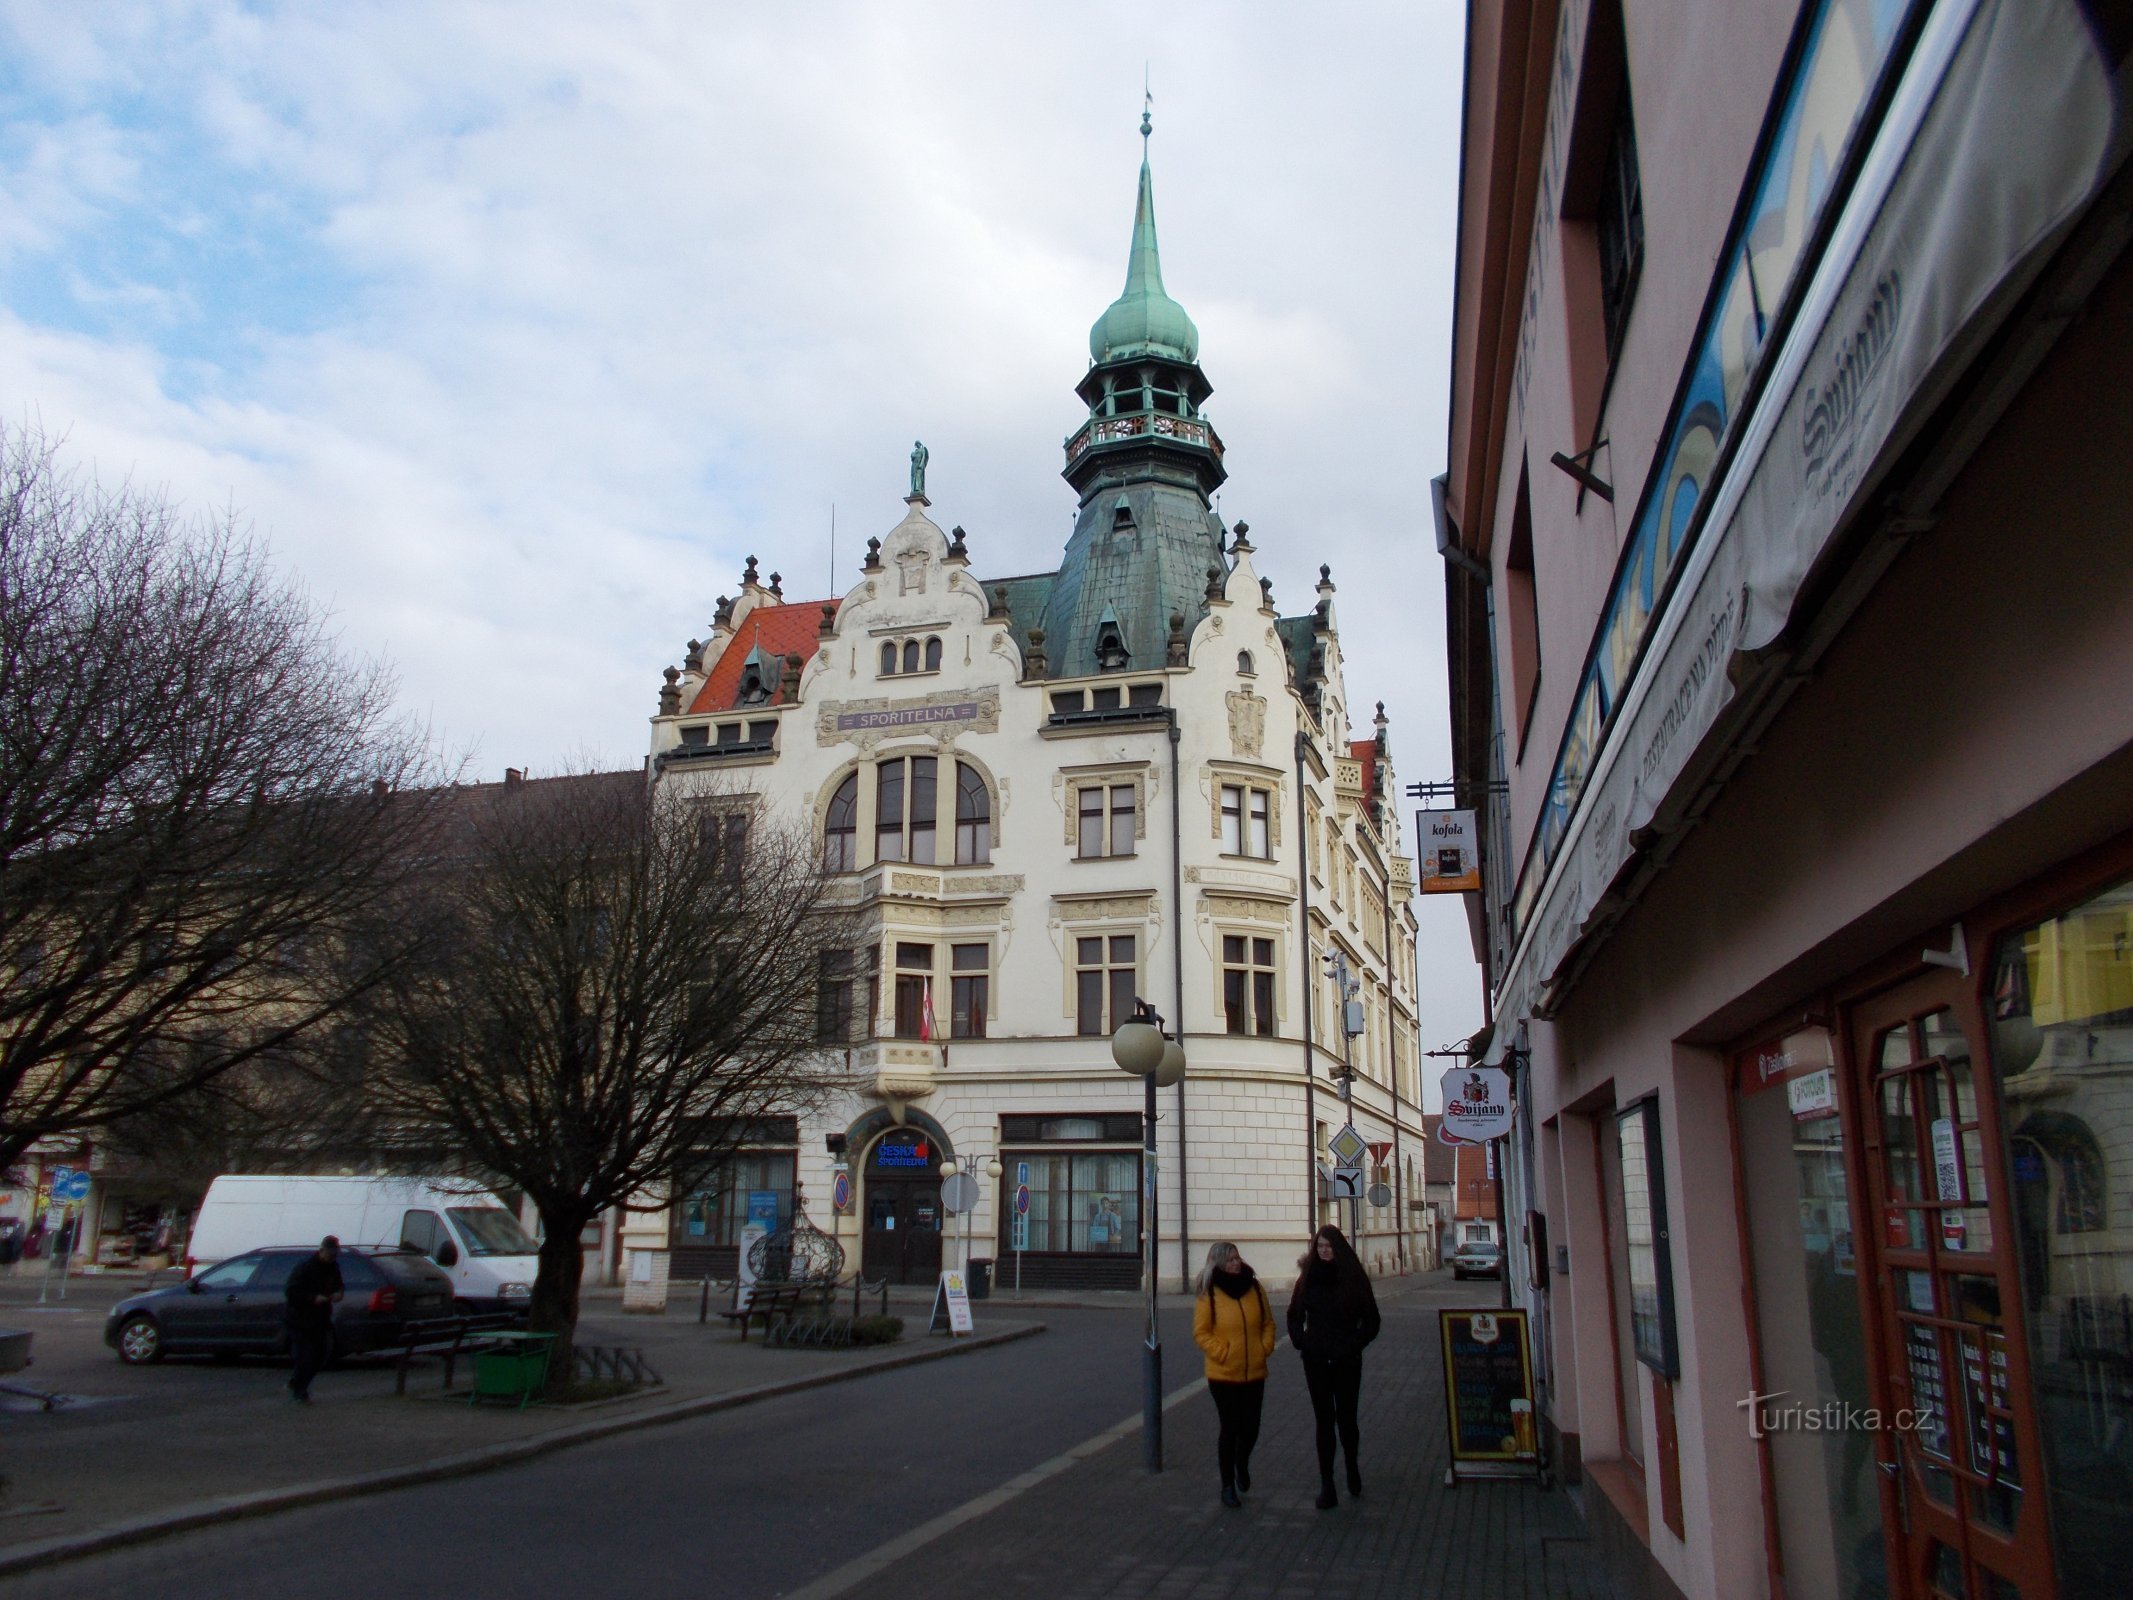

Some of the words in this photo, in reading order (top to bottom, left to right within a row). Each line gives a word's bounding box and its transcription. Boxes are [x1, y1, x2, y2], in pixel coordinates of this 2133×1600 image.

[1642, 678, 1692, 784] RESTAURACE
[1689, 653, 1706, 702] NA
[1432, 823, 1463, 838] kofola
[1448, 1099, 1504, 1117] Svijany
